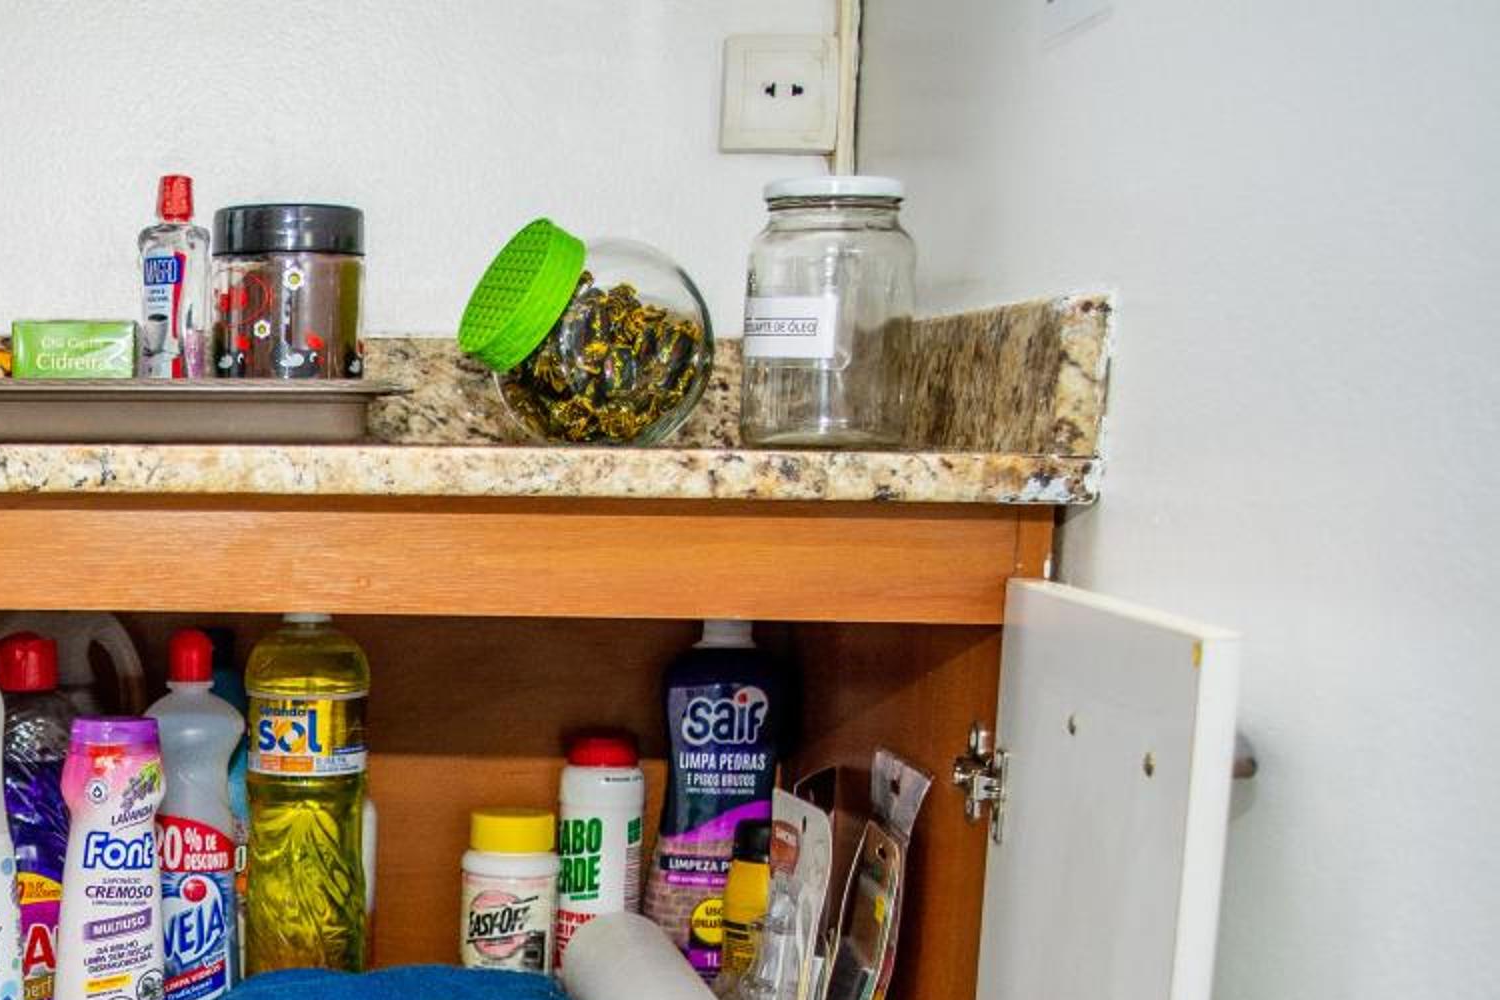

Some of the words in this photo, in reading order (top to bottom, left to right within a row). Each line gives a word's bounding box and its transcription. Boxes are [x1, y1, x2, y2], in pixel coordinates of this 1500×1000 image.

[680, 752, 717, 770] LIMPA
[719, 753, 766, 771] PEDRAS
[669, 858, 719, 871] LIMPEZA
[85, 886, 153, 899] CREMOSO
[92, 915, 146, 936] MULTIUSO
